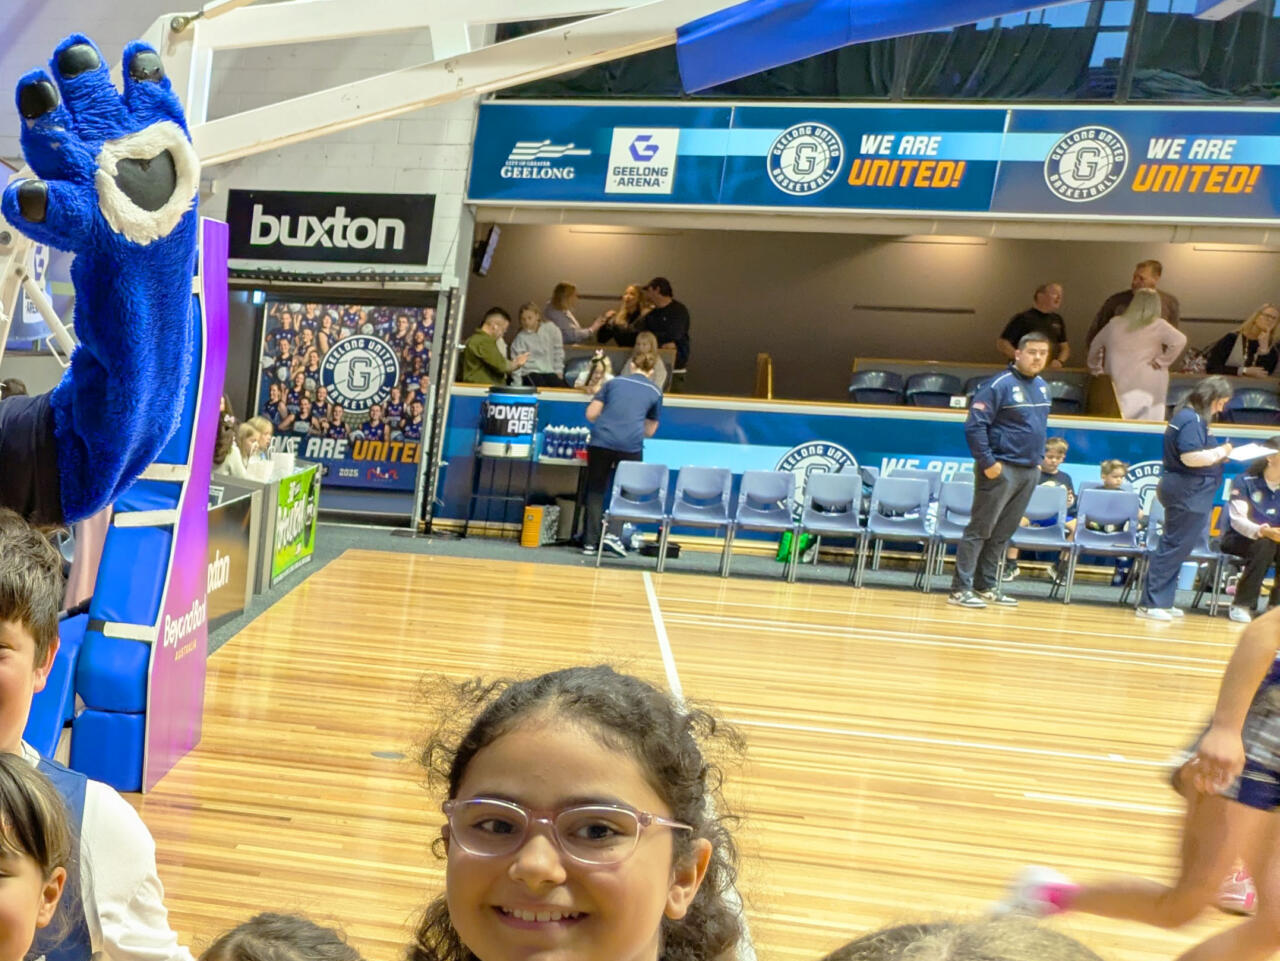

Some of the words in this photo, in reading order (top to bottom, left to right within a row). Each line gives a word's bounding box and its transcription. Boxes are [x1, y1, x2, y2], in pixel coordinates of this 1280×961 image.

[774, 126, 812, 156] GEELONG
[814, 127, 840, 157] UNITED
[859, 134, 895, 155] WE
[897, 135, 942, 156] ARE
[1052, 130, 1095, 161] GEELONG
[1098, 131, 1124, 162] UNITED
[1147, 138, 1185, 160] WE
[1188, 139, 1237, 160] ARE
[612, 166, 668, 177] GEELONG
[792, 143, 818, 175] G
[1072, 147, 1100, 181] G
[500, 166, 575, 180] GEELONG
[616, 177, 661, 187] ARENA
[772, 168, 835, 193] BASKETBALL
[848, 158, 967, 188] UNITED!
[1049, 173, 1118, 199] BASKETBALL
[1131, 164, 1262, 194] UNITED!
[250, 204, 405, 250] buxton
[326, 339, 365, 370] GEELONG
[368, 340, 395, 373] UNITED
[487, 405, 535, 420] POWER
[507, 420, 533, 433] ADE
[305, 437, 348, 459] ARE
[352, 439, 421, 464] UNITE
[783, 445, 824, 471] EELONG
[1127, 465, 1160, 482] LONG
